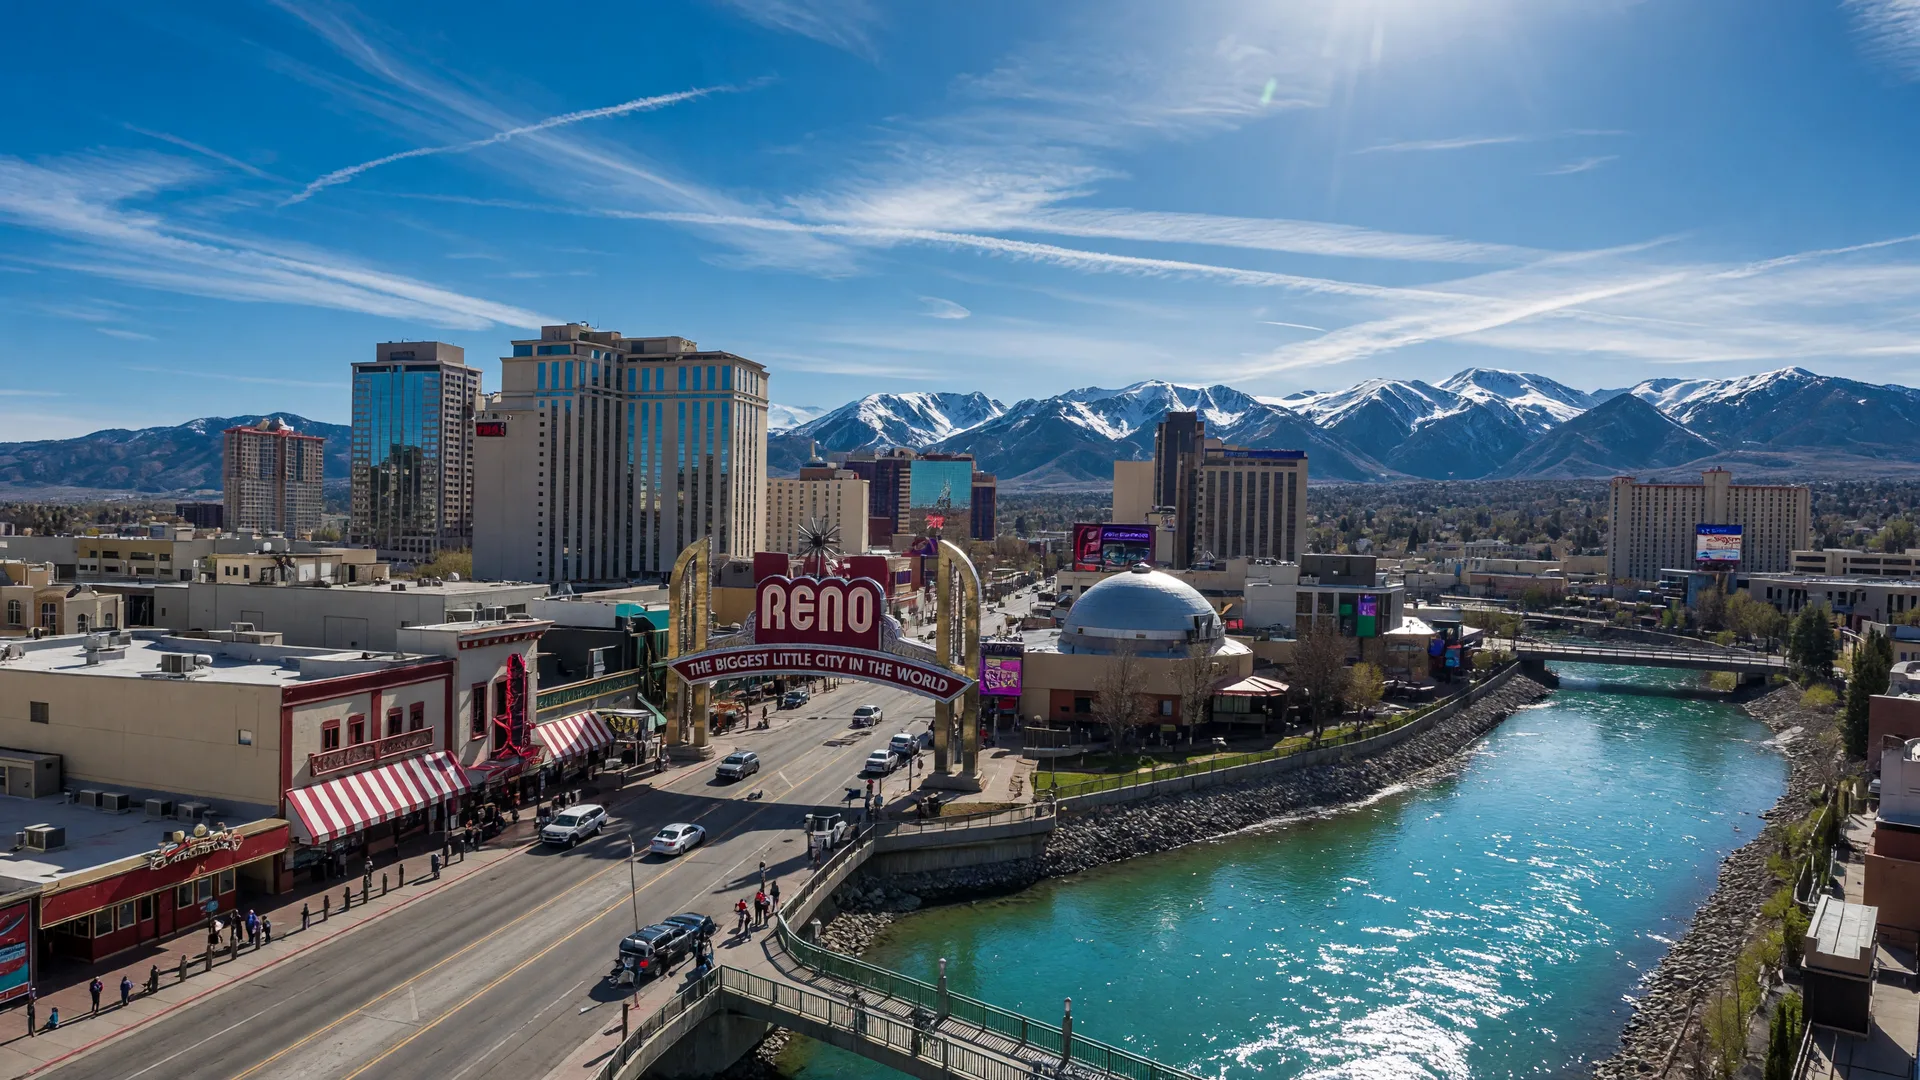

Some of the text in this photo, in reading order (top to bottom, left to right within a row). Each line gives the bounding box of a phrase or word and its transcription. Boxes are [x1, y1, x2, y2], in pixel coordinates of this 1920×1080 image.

[761, 584, 873, 634] RENO
[687, 652, 948, 692] THE BIGGEST LITTLE CITY IN THE WORLD
